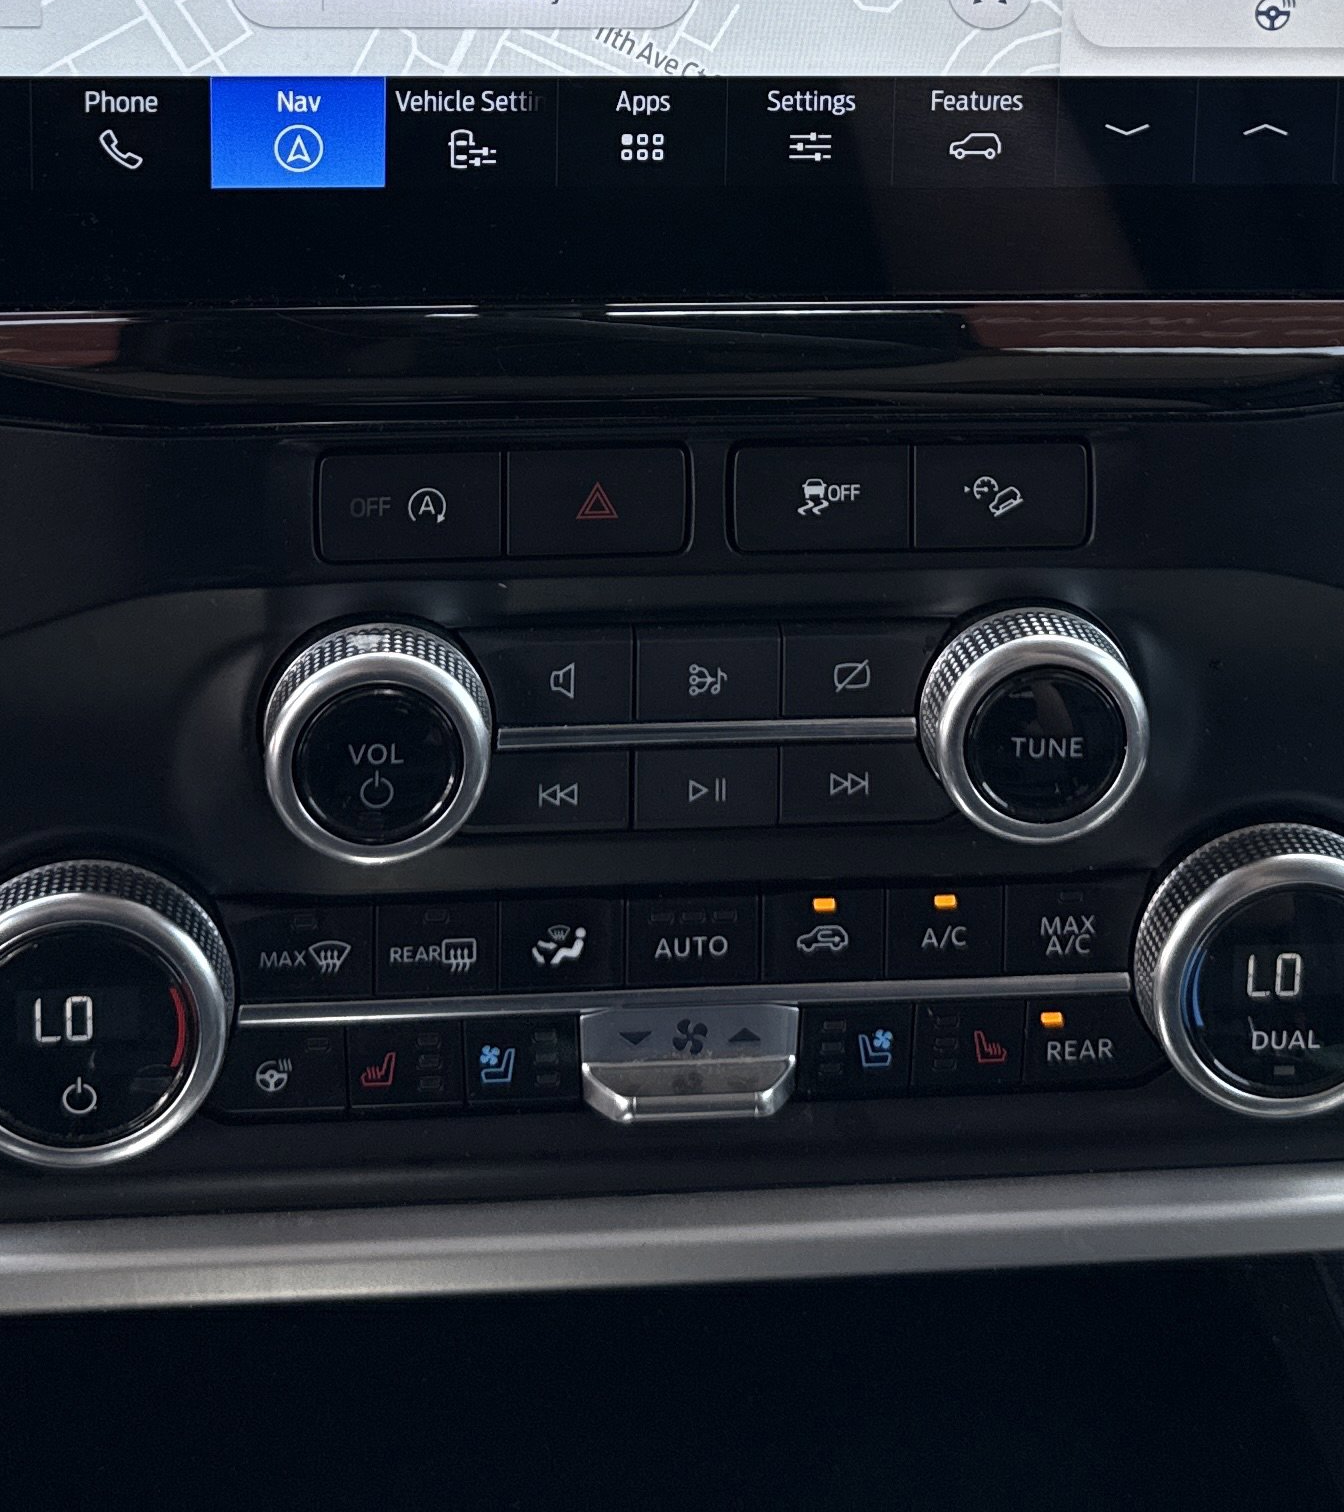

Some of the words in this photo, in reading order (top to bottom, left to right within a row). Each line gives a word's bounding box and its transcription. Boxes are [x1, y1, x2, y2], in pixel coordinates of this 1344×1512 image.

[635, 41, 680, 76] Ave
[83, 90, 159, 114] Phone
[276, 90, 322, 114] Nav
[394, 89, 476, 113] Vehicle
[615, 90, 672, 118] Apps
[766, 89, 857, 117] Settings
[929, 89, 1024, 113] Features
[827, 483, 861, 502] OFF
[349, 495, 392, 518] OFF
[348, 743, 405, 767] VOL
[1011, 736, 1084, 760] TUNE
[1040, 914, 1096, 936] MAX
[654, 935, 729, 961] AUTO
[921, 925, 968, 951] A/C
[1045, 933, 1092, 957] A/C
[259, 949, 307, 970] MAX
[389, 944, 441, 965] REAR
[1246, 951, 1302, 997] LO
[34, 994, 94, 1044] LO
[1046, 1037, 1114, 1064] REAR
[1250, 1029, 1322, 1051] DUAL
